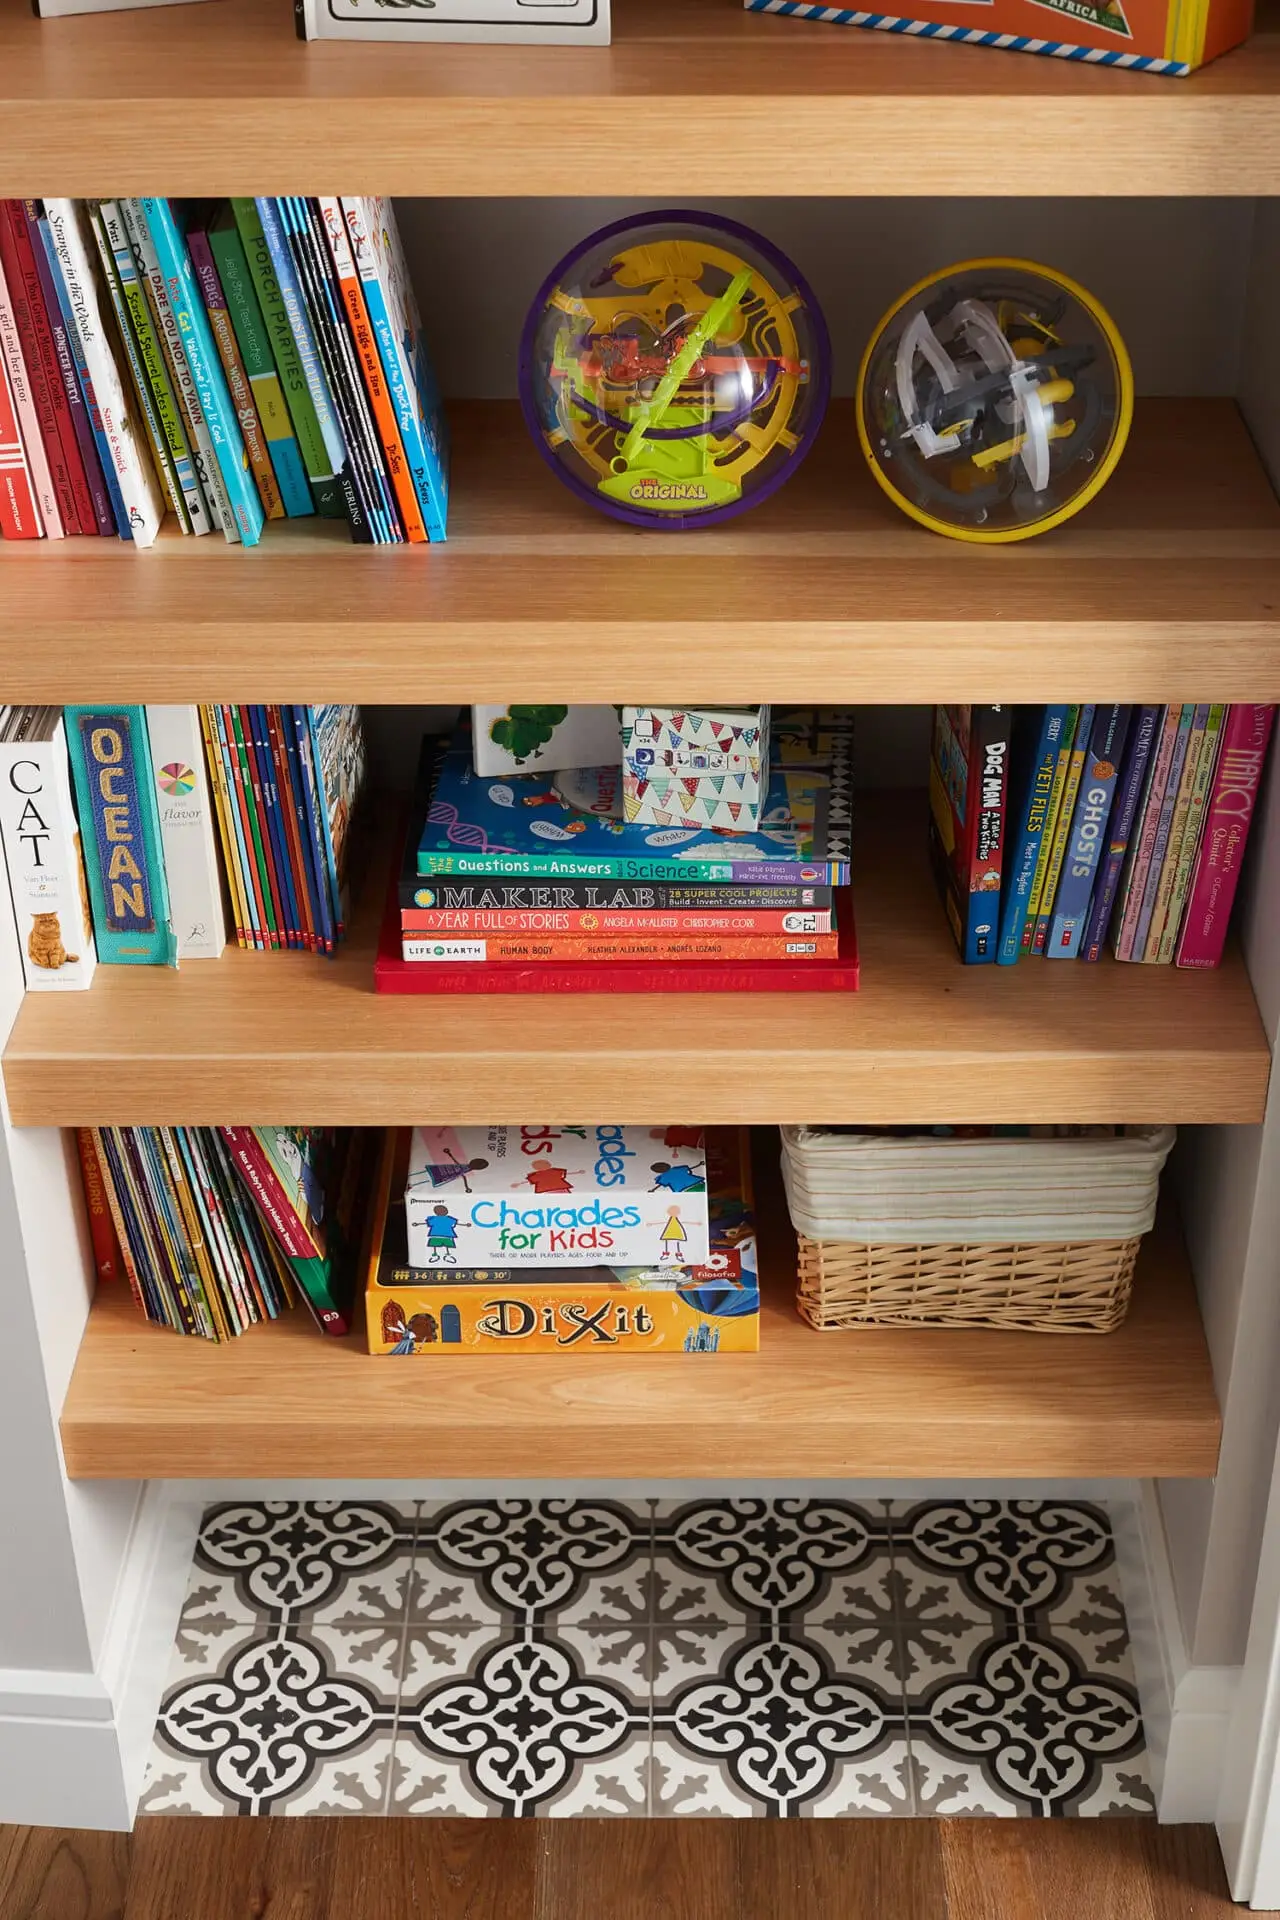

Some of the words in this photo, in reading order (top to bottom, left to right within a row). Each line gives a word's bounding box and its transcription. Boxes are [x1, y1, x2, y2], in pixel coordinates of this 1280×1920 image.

[46, 207, 74, 266] Stranger
[107, 219, 121, 243] Watt
[65, 267, 76, 280] in
[222, 255, 240, 280] Jelly
[26, 281, 40, 300] You
[69, 280, 83, 300] the
[151, 274, 168, 307] DARE
[230, 279, 247, 305] Shot
[0, 312, 13, 331] girl
[31, 301, 46, 324] Give
[74, 298, 94, 342] Woods
[162, 312, 177, 337] YOU
[239, 306, 252, 327] Test
[249, 235, 280, 304] PORCH
[270, 310, 303, 392] PARTIES
[4, 333, 18, 353] and
[212, 310, 233, 354] AROUND
[347, 289, 362, 319] Green
[355, 323, 371, 349] Eggs
[363, 352, 375, 371] and
[369, 374, 382, 397] Ham
[379, 327, 392, 346] Wish
[38, 334, 55, 367] Mouse
[52, 325, 73, 369] MONSTER
[170, 340, 185, 365] NOT
[243, 328, 264, 368] Kitchen
[9, 356, 22, 373] her
[127, 292, 148, 334] Scaredy
[140, 336, 161, 379] Squirrel
[153, 380, 171, 410] makes
[164, 419, 182, 451] friend
[166, 276, 183, 302] Pete
[177, 310, 193, 333] Cat
[185, 336, 208, 388] Valentine's
[211, 423, 224, 444] Cool
[12, 376, 29, 403] gator
[179, 370, 192, 386] TO
[228, 365, 246, 400] WORLD
[48, 376, 66, 410] Cookie
[392, 383, 409, 409] Duck
[185, 389, 202, 425] YAWN
[237, 406, 257, 430] 80
[397, 409, 416, 432] Feet
[109, 434, 118, 443] &
[246, 429, 263, 462] DRINKS
[4, 476, 15, 496] SIMON
[203, 448, 220, 489] CANDLEWICK
[216, 490, 226, 508] PRESS
[413, 466, 426, 481] Dr.
[341, 479, 361, 525] STERLING
[417, 480, 433, 505] Seuss
[630, 485, 707, 499] ORIGINAL
[8, 497, 24, 531] SPOTLIGHT
[1046, 716, 1061, 741] SHERRY
[1134, 715, 1153, 759] CARMEN
[980, 738, 1006, 776] DOG
[1035, 763, 1052, 794] YETI
[1053, 775, 1061, 793] LOST
[1213, 744, 1261, 821] NANCY
[979, 776, 1004, 809] MAN
[9, 760, 51, 867] CAT
[91, 728, 147, 918] OCEAN
[162, 809, 202, 822] flavor
[1025, 796, 1047, 833] FILES
[1071, 786, 1107, 878] GHOSTS
[990, 840, 999, 850] of
[1024, 841, 1036, 859] Meet
[1206, 826, 1228, 868] Quintet
[1221, 823, 1242, 873] Collector's
[458, 859, 530, 872] Questions
[550, 861, 611, 874] Answers
[627, 861, 698, 878] Science
[444, 887, 579, 908] MAKER
[585, 887, 655, 908] LAB
[684, 890, 716, 898] SUPER
[719, 889, 746, 897] COOL
[749, 889, 798, 897] PROJECTS
[428, 915, 435, 924] A
[436, 912, 469, 928] YEAR
[474, 913, 504, 928] FULL
[505, 915, 518, 925] OF
[519, 913, 570, 929] STORIES
[603, 918, 634, 927] ANGELA
[682, 918, 729, 928] CHRISTOPHER
[732, 918, 755, 928] CORR
[500, 947, 529, 955] HUMAN
[532, 946, 553, 954] BODY
[238, 1149, 249, 1164] Max
[247, 1169, 262, 1189] Ruby's
[257, 1188, 273, 1209] Happy
[268, 1207, 286, 1233] Holidays
[280, 1232, 298, 1256] Treasury
[470, 1199, 641, 1229] Charades
[498, 1228, 542, 1250] for
[550, 1227, 614, 1251] Kids
[414, 1272, 428, 1280] 3-6
[455, 1272, 466, 1280] 8+
